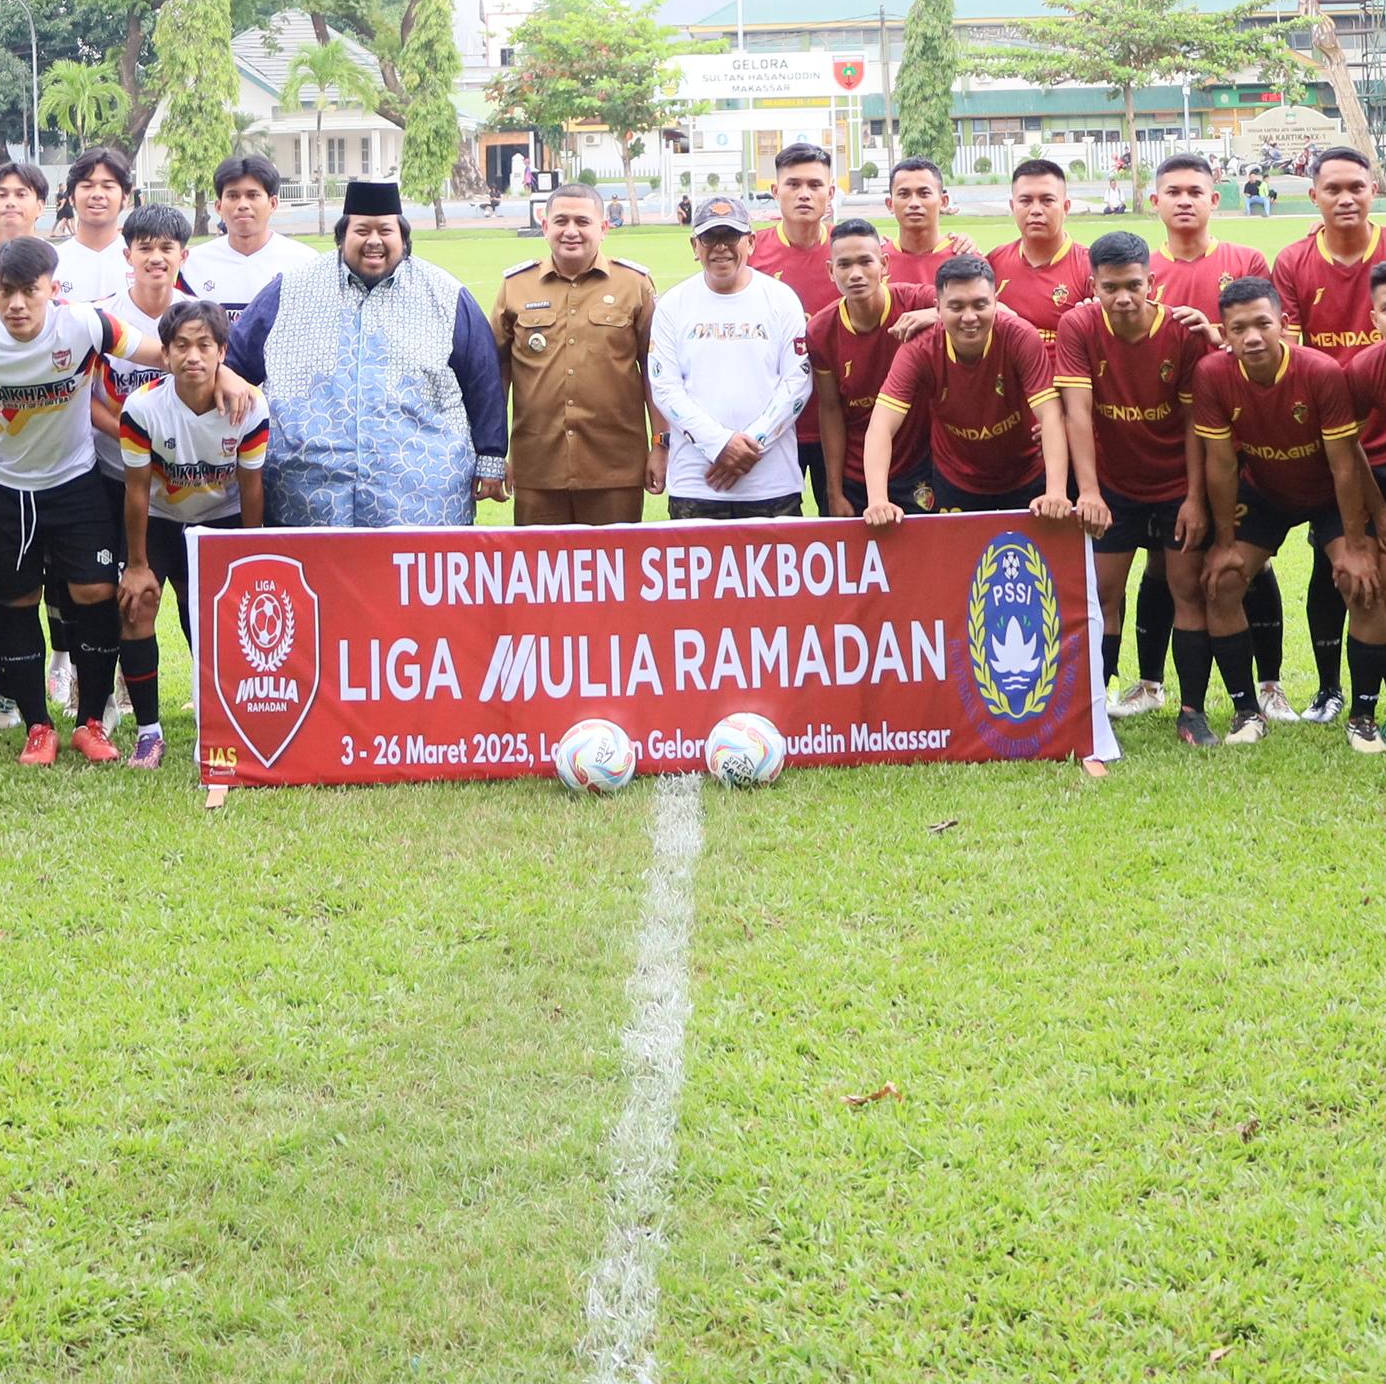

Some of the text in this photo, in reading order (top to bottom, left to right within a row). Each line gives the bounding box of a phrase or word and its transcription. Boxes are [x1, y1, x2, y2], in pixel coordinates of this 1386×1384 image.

[732, 59, 789, 71] GELORA
[702, 72, 821, 82] SULTAN HASANUDDIN
[732, 84, 790, 93] MAKASSAR
[1311, 329, 1385, 348] MENDAG
[53, 379, 76, 395] FC
[392, 539, 891, 606] TURNAMEN SEPAKBOLA
[255, 580, 276, 592] LIGA
[993, 584, 1033, 606] PSSI
[338, 619, 947, 704] LIGA MULIA RAMADAN
[235, 676, 300, 705] MULIA
[247, 701, 288, 713] RAMADAN
[341, 736, 354, 765] 3
[373, 735, 401, 765] 26
[415, 734, 467, 764] Maret
[473, 733, 534, 768] 2025,
[648, 729, 707, 760] Gelor
[851, 721, 951, 753] Makassar
[595, 737, 608, 764] SPECS
[209, 747, 238, 768] IAS
[727, 756, 754, 775] SPECS
